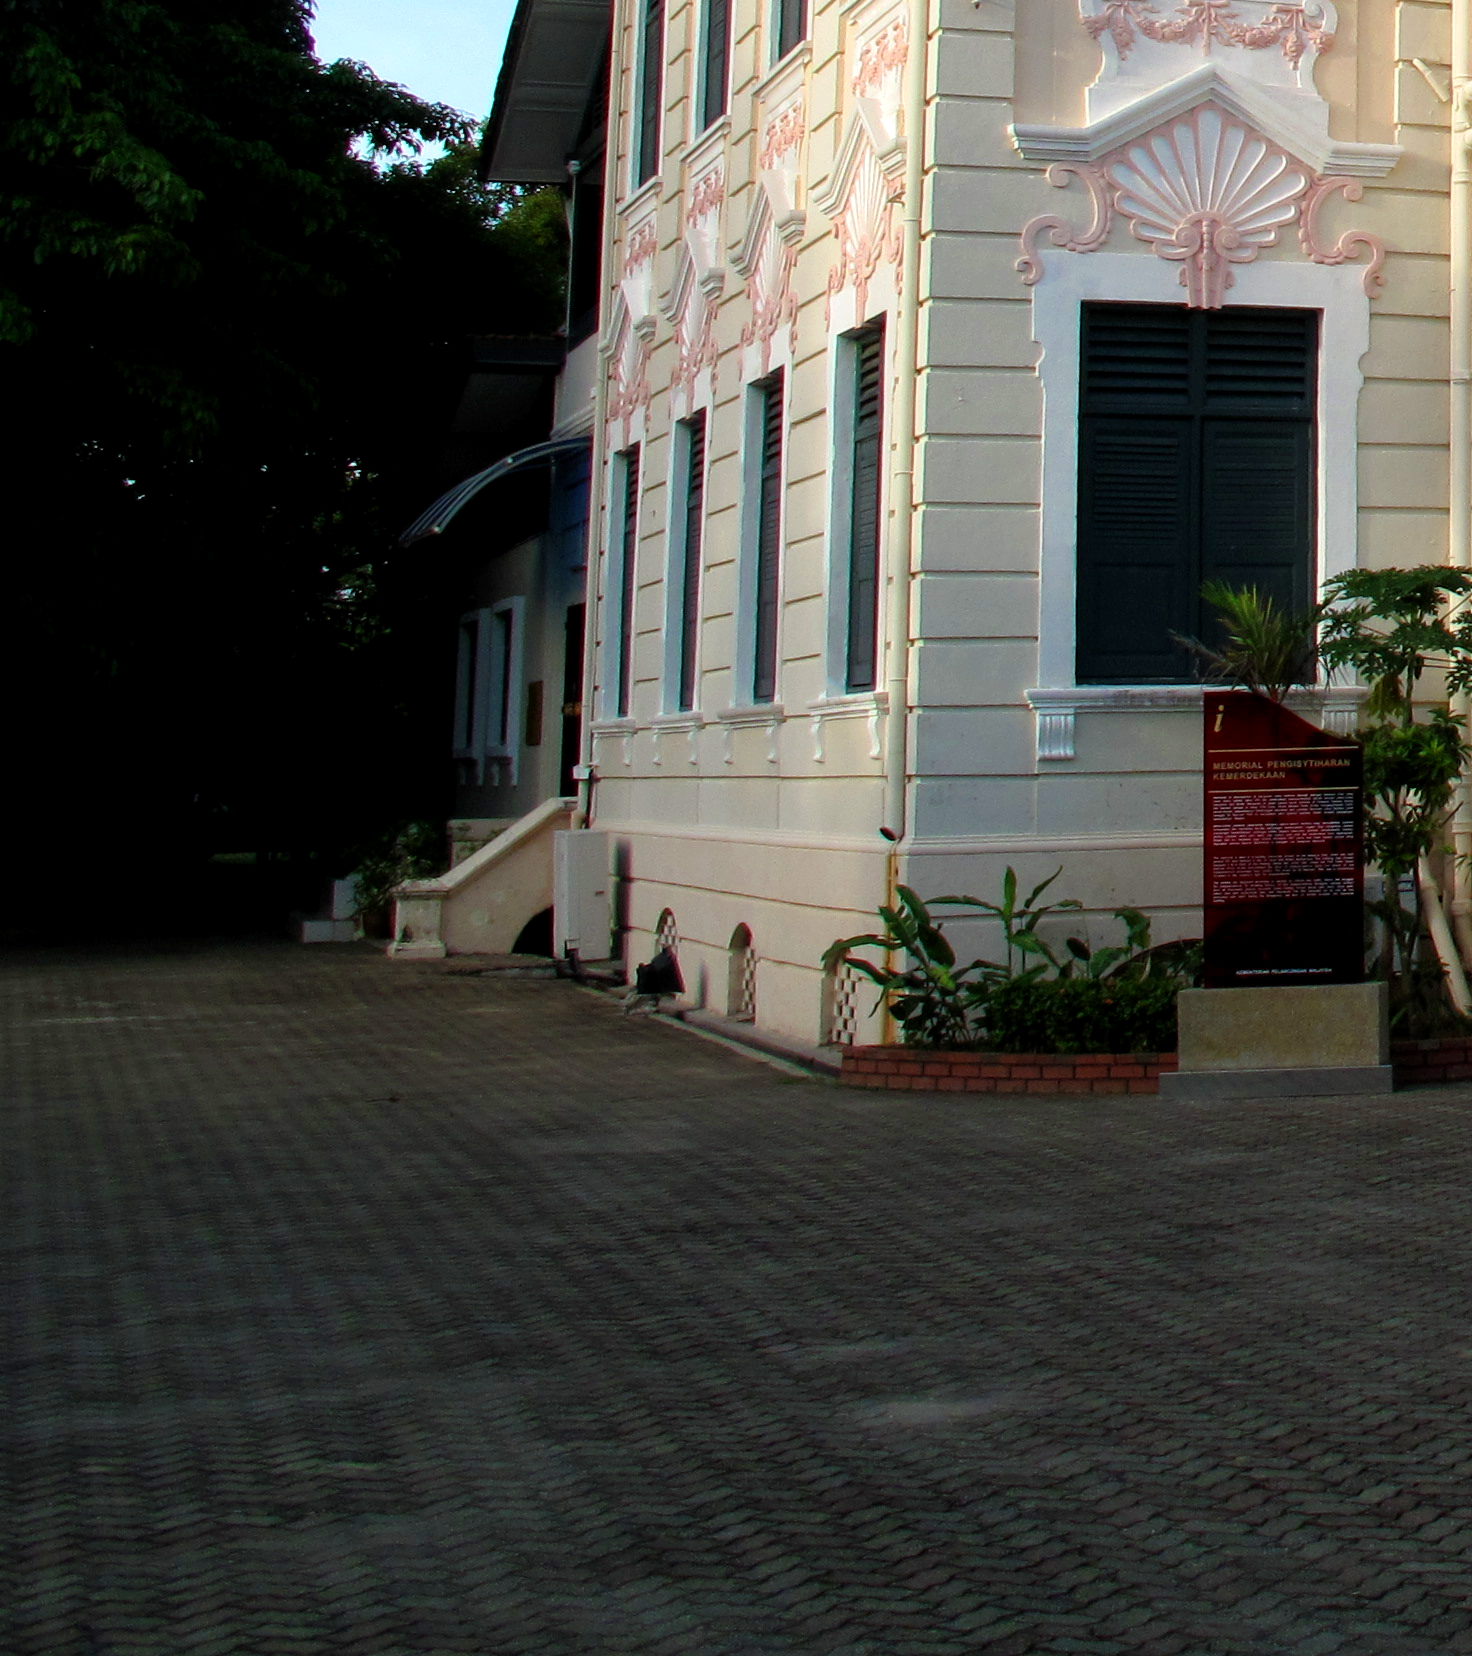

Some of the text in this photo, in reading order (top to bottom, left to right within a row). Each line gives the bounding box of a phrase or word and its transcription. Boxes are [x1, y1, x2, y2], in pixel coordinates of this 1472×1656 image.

[1212, 759, 1351, 770] MEMORIAL PENGISYTIHARAN
[1212, 771, 1286, 781] KEMERDEKAAN
